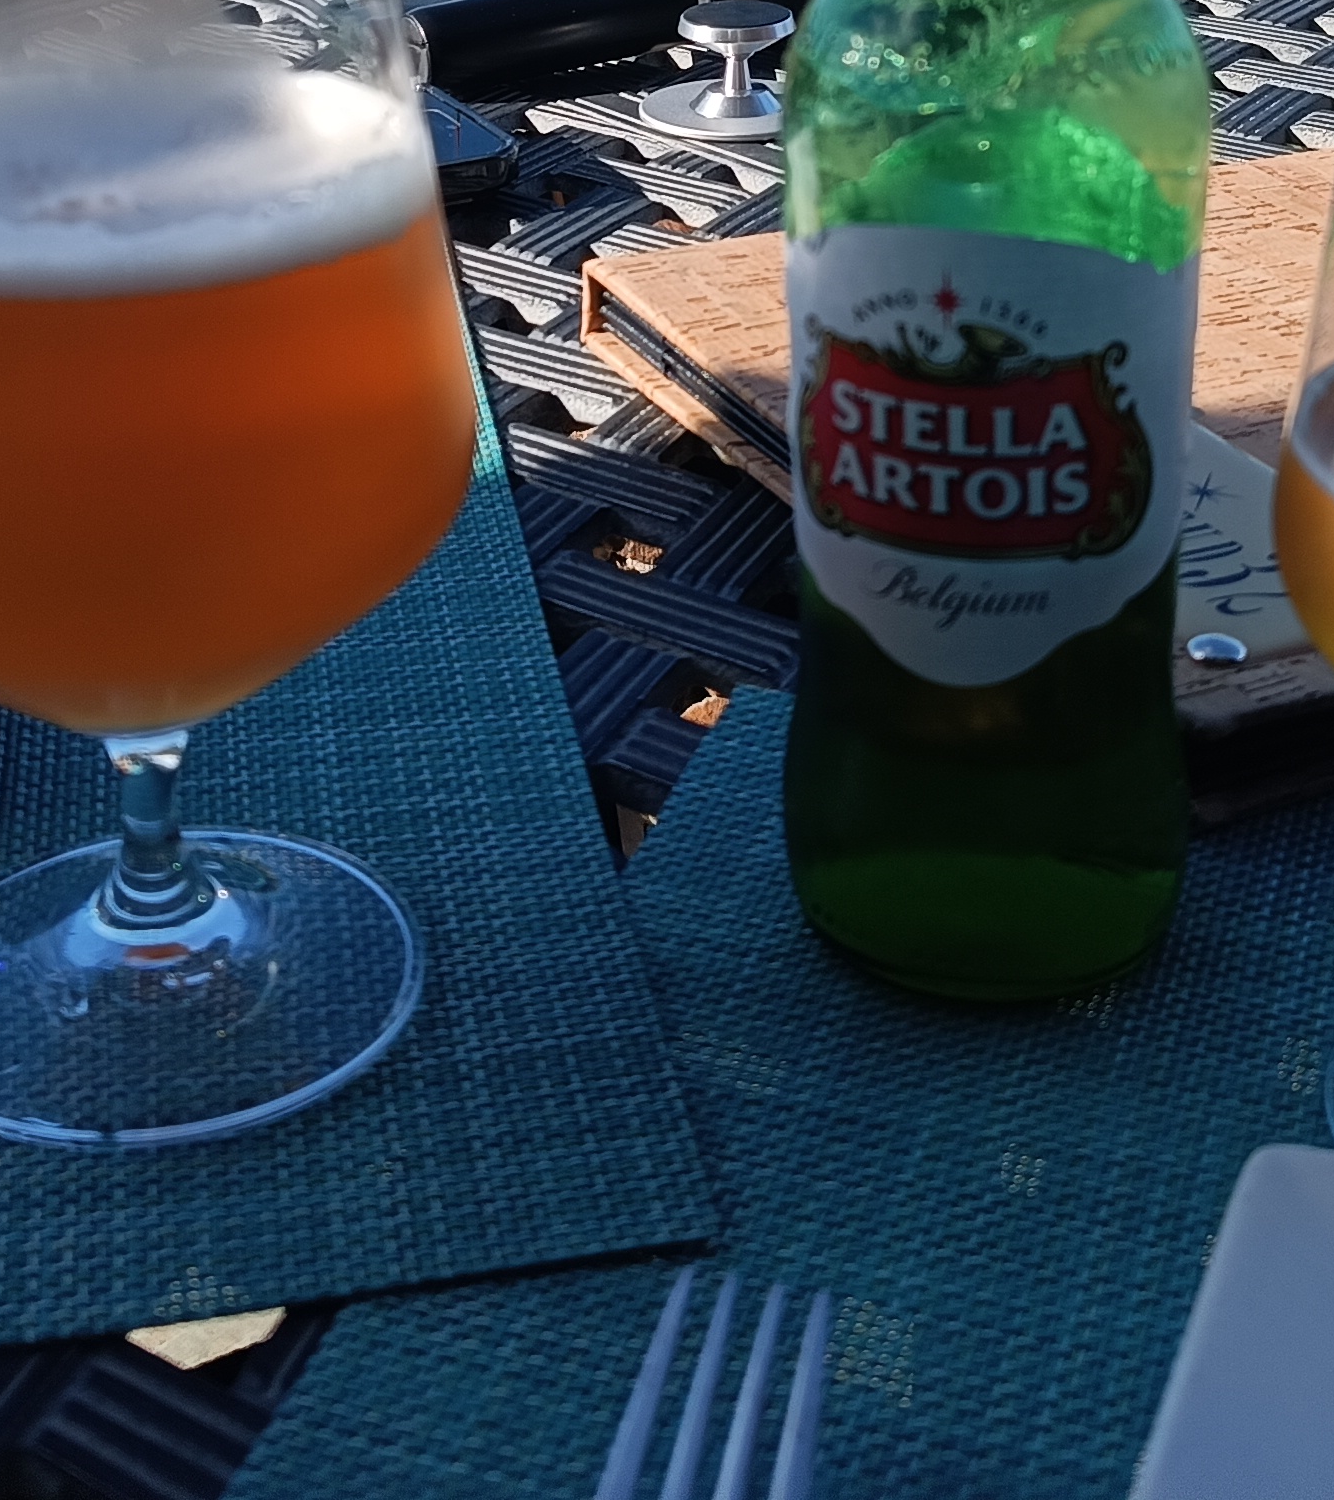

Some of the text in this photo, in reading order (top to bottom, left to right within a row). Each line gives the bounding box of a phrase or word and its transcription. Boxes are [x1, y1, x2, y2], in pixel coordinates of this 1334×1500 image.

[830, 379, 1087, 459] STELLA
[830, 442, 1092, 521] ARTOIS
[867, 558, 1051, 632] Belgium
